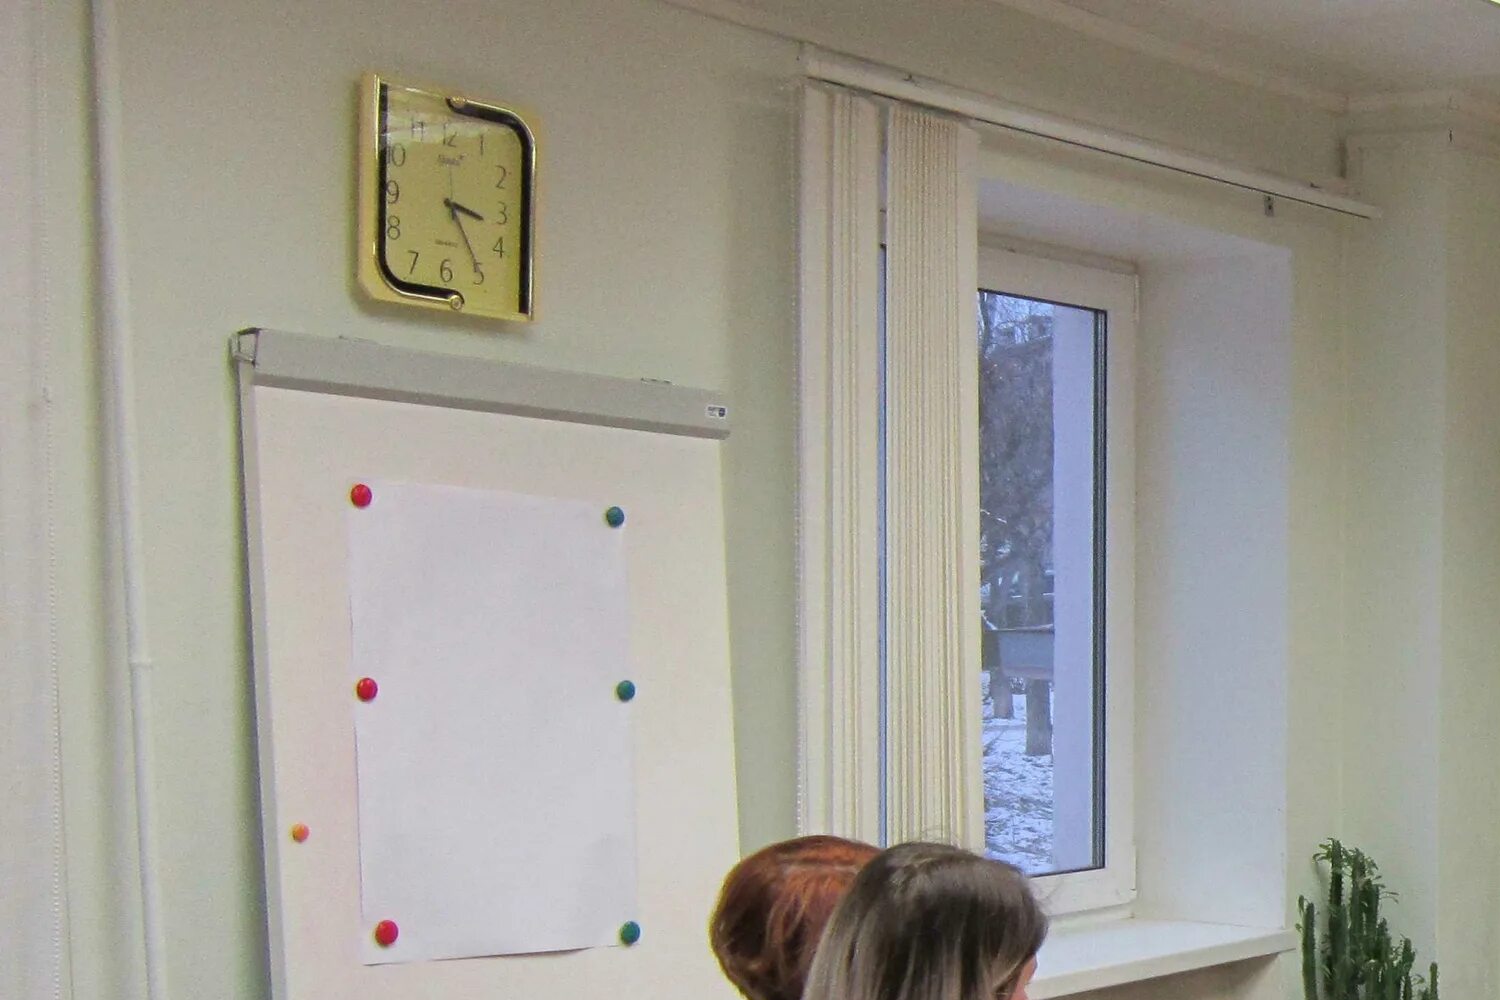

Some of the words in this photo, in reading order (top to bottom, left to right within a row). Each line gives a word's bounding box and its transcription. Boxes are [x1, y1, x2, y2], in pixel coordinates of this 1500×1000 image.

[443, 123, 457, 147] 12
[480, 133, 484, 156] 1
[386, 143, 406, 167] 10
[495, 165, 507, 189] 2
[386, 180, 399, 204] 9
[496, 202, 508, 225] 3
[387, 215, 400, 240] 8
[492, 236, 504, 259] 4
[408, 250, 419, 275] 7
[440, 259, 453, 283] 6
[472, 261, 484, 285] 5
